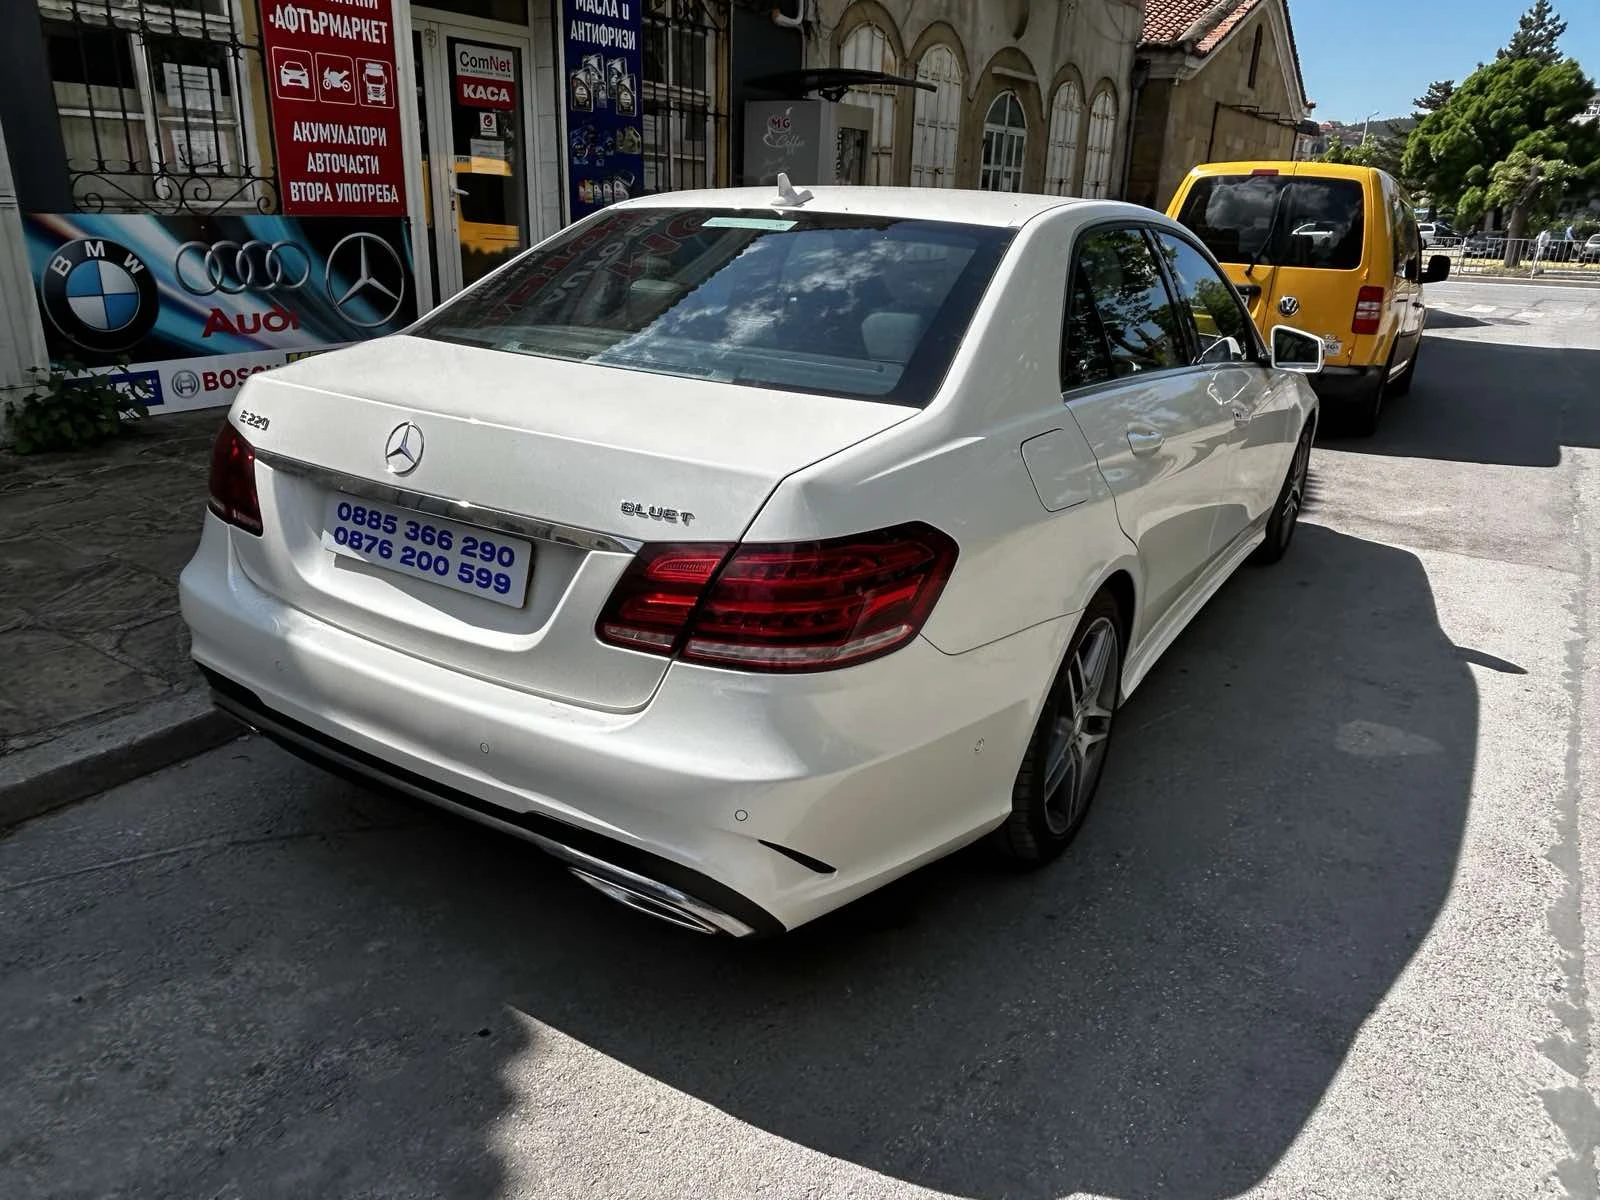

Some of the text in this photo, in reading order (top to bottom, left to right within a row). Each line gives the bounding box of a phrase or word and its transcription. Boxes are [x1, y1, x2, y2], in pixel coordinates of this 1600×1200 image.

[571, 20, 636, 50] АНТИФРИЗИ
[459, 51, 511, 72] ComNet
[463, 84, 510, 102] КАСА
[293, 121, 387, 146] АКУМУЛАТОРИ
[307, 152, 380, 174] АВТОЧАСТИ
[290, 182, 399, 203] ВТОРА УПОТРЕБА
[50, 241, 144, 277] BMW
[337, 502, 515, 567] 0885 366 290
[334, 527, 511, 594] 0876 200 599
